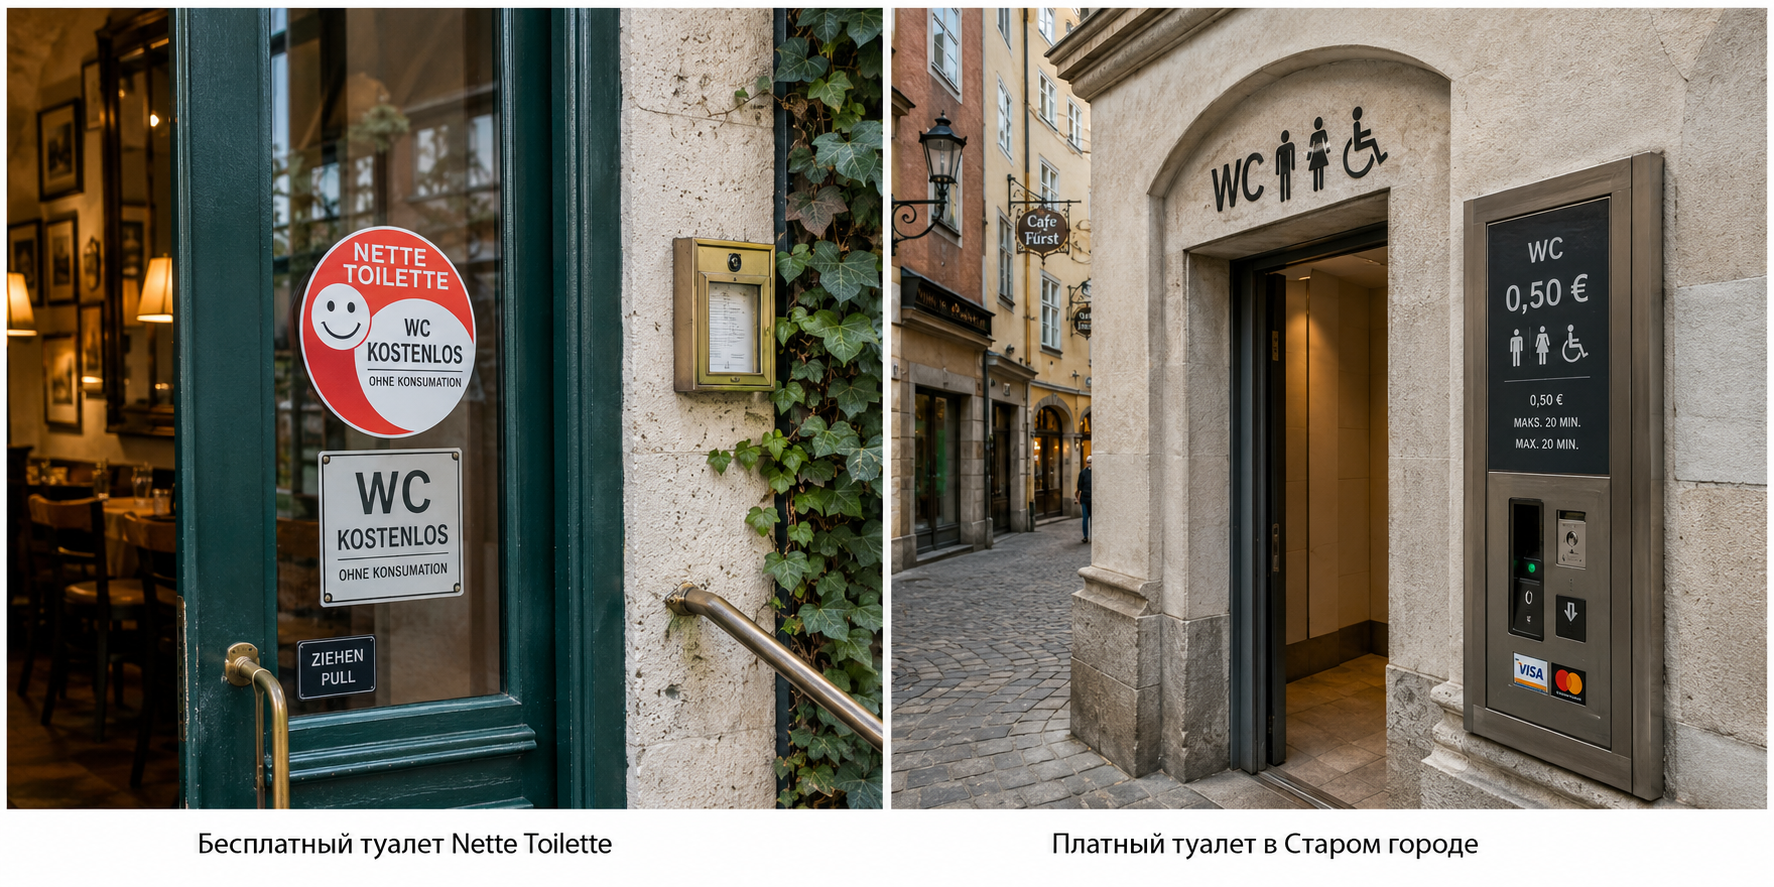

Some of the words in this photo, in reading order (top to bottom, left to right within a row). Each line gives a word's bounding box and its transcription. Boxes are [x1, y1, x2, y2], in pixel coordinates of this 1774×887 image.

[1211, 152, 1264, 212] WC
[1027, 214, 1057, 229] Cafe
[354, 242, 426, 267] NETTE
[1528, 236, 1564, 263] WC
[343, 264, 449, 290] TOILETTE
[1505, 278, 1562, 314] 0,50
[1570, 273, 1589, 303] €
[404, 318, 430, 337] WC
[367, 342, 463, 364] KOSTENLOS
[369, 376, 395, 386] OHNE
[397, 376, 462, 388] KONSUMATION
[1530, 394, 1553, 406] 0,50
[1555, 394, 1563, 406] €
[1513, 417, 1542, 428] MAKS.
[1545, 417, 1557, 427] 20
[1559, 417, 1581, 427] MIN.
[1515, 438, 1539, 449] MAX.
[1542, 438, 1553, 449] 20
[1556, 439, 1578, 450] MIN.
[355, 470, 431, 515] WC
[338, 524, 448, 550] KOSTENLOS
[339, 568, 370, 581] OHNE
[373, 562, 448, 579] KONSUMATION
[311, 649, 364, 667] ZIEHEN
[321, 671, 356, 686] PULL
[1518, 662, 1543, 680] VISA
